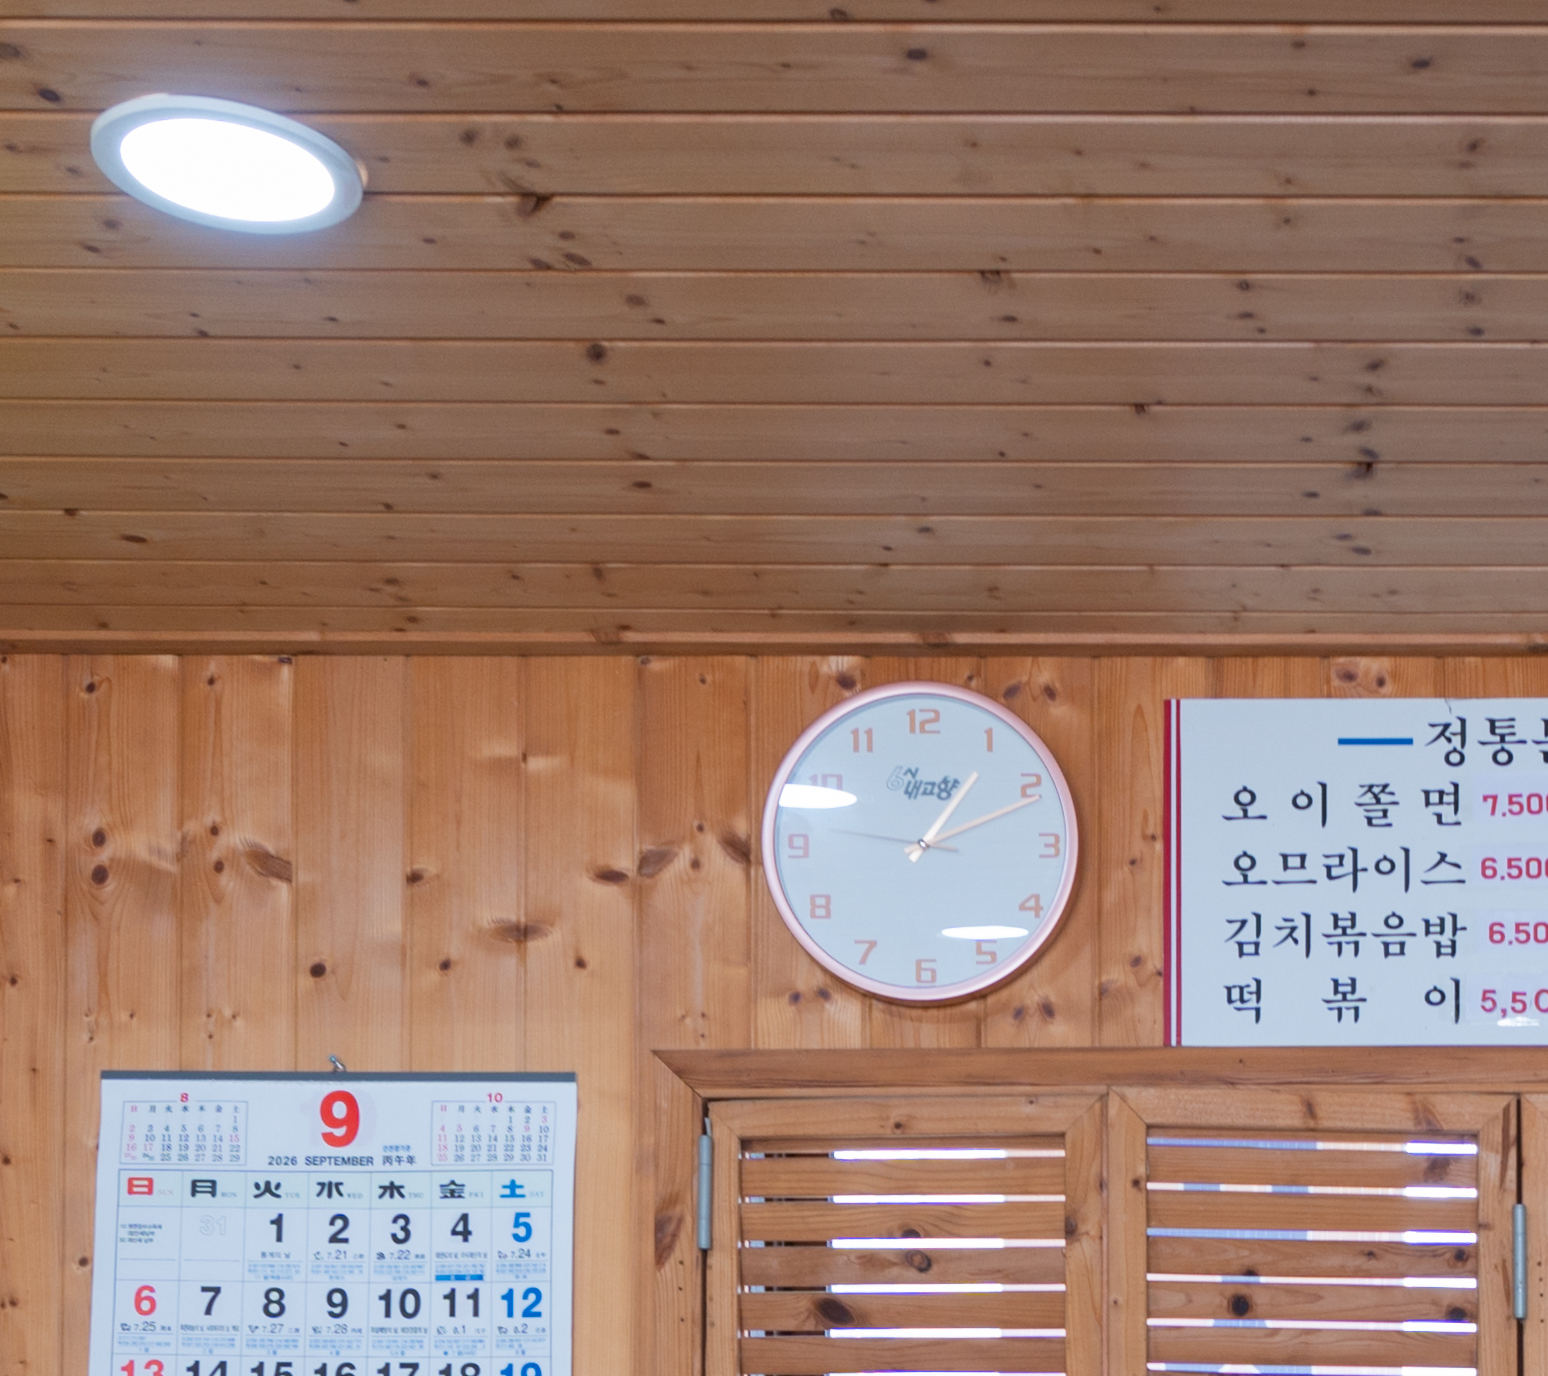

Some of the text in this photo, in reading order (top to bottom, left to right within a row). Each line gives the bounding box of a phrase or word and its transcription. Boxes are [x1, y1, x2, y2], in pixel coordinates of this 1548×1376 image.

[906, 708, 940, 734] 12
[850, 727, 873, 752] 11
[984, 727, 993, 752] 1
[1020, 773, 1042, 798] 2
[788, 833, 809, 858] 9
[1039, 833, 1060, 858] 3
[1221, 846, 1466, 893] 오므라이스
[810, 894, 831, 919] 8
[1018, 894, 1043, 918] 4
[1224, 911, 1467, 959] 김치볶음밥
[854, 940, 877, 965] 7
[976, 939, 997, 965] 5
[915, 959, 937, 983] 6
[180, 1092, 189, 1103] 8
[487, 1092, 503, 1103] 10
[320, 1090, 360, 1148] 9
[267, 1155, 298, 1166] 2026
[304, 1155, 374, 1166] SEPTEMBER
[127, 1177, 526, 1200] 日 月 火 水 木 金 土
[270, 1212, 532, 1245] 1 2 3 4 5
[134, 1285, 542, 1319] 6 7 8 9 10 11 12
